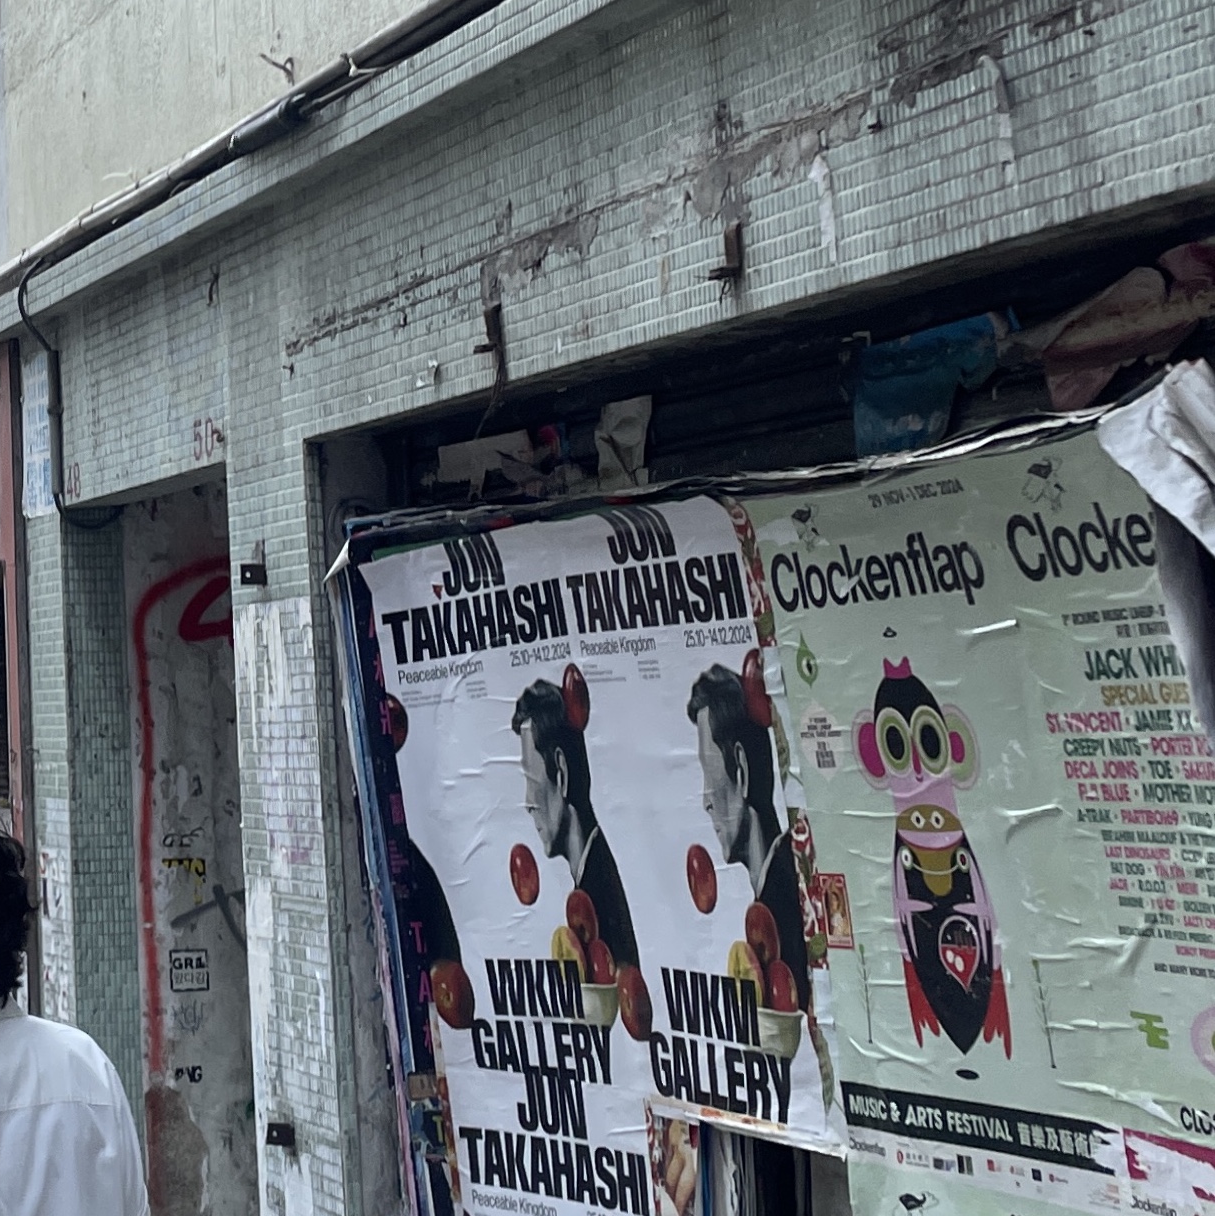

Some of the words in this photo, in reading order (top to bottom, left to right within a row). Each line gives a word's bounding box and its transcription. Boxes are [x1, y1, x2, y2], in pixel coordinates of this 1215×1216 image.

[771, 531, 984, 613] Clockenflap
[1006, 501, 1156, 581] Clocke
[382, 578, 569, 665] TAKAHASHI
[567, 552, 747, 635] TAKAHASHI
[398, 664, 448, 685] Peaceable
[449, 660, 484, 682] Kingdom
[580, 639, 619, 656] Peaceable
[620, 635, 657, 656] Kingdom
[1085, 647, 1138, 681] JACK
[1101, 683, 1159, 707] SPECIAL
[1064, 760, 1098, 779] DECA
[1148, 760, 1173, 779] TOE
[484, 958, 585, 1018] WKM
[661, 966, 761, 1047] WKM
[471, 1018, 613, 1085] GALLERY
[649, 1031, 791, 1124] GALLERY
[517, 1068, 588, 1140] JUN
[849, 1094, 888, 1121] MUSIC
[890, 1101, 901, 1122] &
[905, 1104, 943, 1130] ARTS
[947, 1110, 1013, 1143] FESTIVAL
[459, 1126, 650, 1216] TAKAHASHI
[472, 1189, 518, 1214] Peaceable
